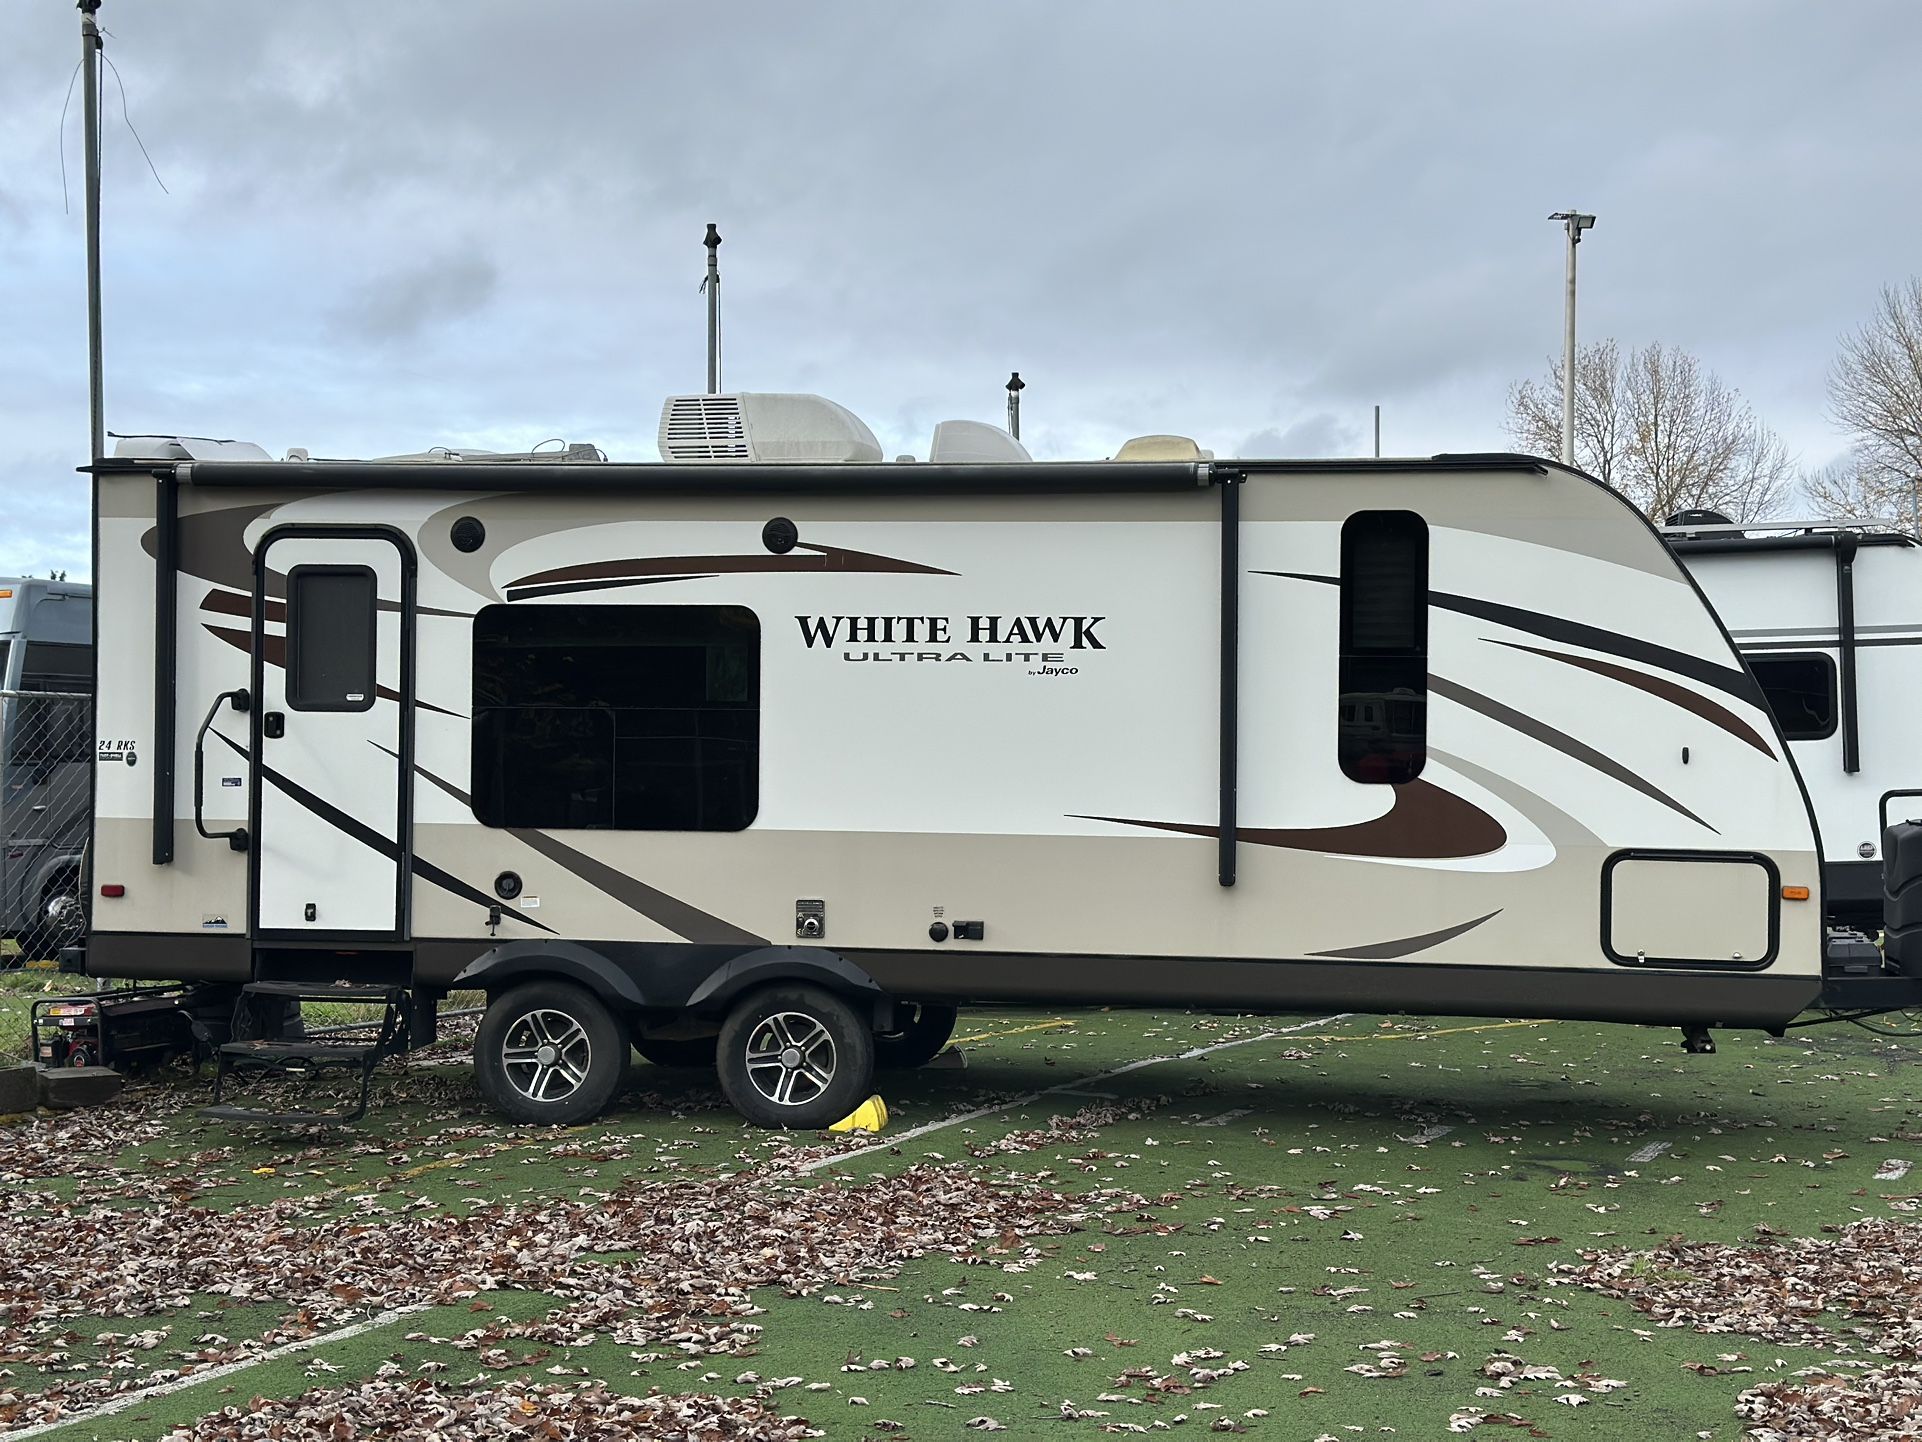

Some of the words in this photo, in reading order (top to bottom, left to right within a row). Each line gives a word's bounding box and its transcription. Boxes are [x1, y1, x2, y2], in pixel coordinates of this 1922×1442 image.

[795, 615, 951, 649] WHITE
[966, 615, 1106, 650] HAWK
[843, 652, 973, 662] ULTRA
[983, 652, 1065, 663] LITE
[1028, 669, 1036, 677] by
[1037, 665, 1079, 677] Jayco
[98, 740, 112, 751] 24
[116, 740, 136, 751] RKS
